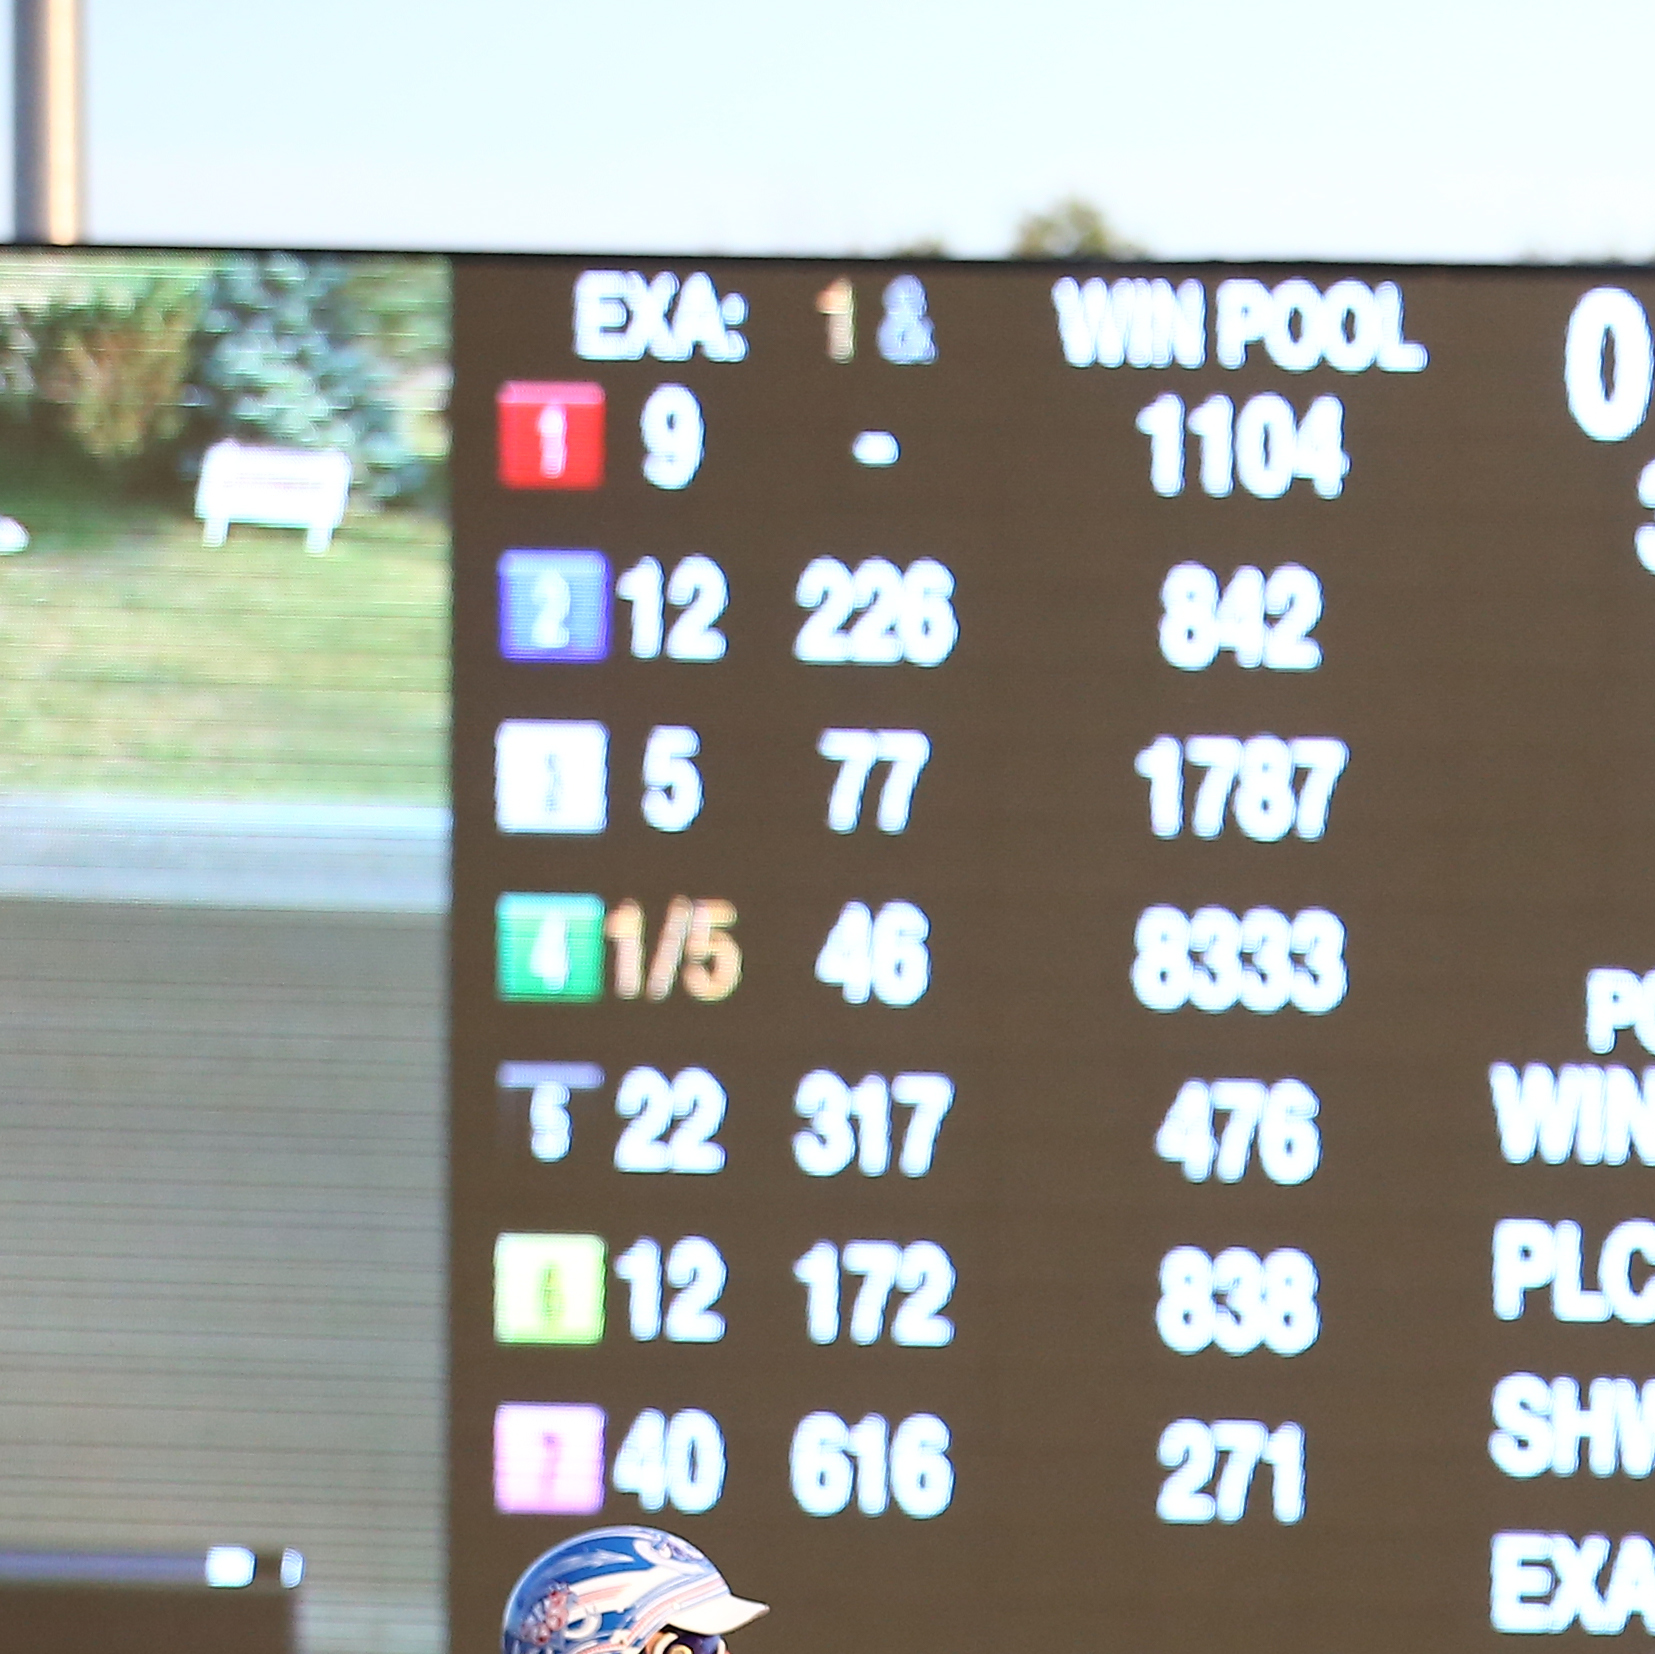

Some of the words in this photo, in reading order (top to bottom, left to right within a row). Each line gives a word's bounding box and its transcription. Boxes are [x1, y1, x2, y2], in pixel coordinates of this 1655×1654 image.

[574, 271, 745, 361] EXA:
[818, 276, 857, 363] 1
[1052, 277, 1205, 368] WIN
[1215, 279, 1427, 371] POOL
[1564, 287, 1654, 440] 0
[537, 402, 567, 478] 1
[640, 384, 703, 489] 9
[1136, 392, 1349, 499] 1104
[531, 567, 571, 648] 2
[616, 556, 726, 659] 12
[793, 558, 958, 666] 226
[1158, 561, 1321, 670] 842
[641, 726, 701, 831] 5
[818, 729, 929, 831] 77
[1134, 736, 1346, 841] 1787
[529, 910, 568, 991] 4
[605, 897, 743, 1001] 1/5
[815, 902, 928, 1004] 46
[1130, 906, 1347, 1012] 8333
[614, 1066, 726, 1173] 22
[792, 1070, 952, 1177] 317
[1156, 1079, 1319, 1184] 476
[614, 1236, 726, 1341] 12
[793, 1240, 955, 1346] 172
[1155, 1246, 1318, 1353] 838
[612, 1409, 725, 1513] 40
[789, 1412, 953, 1518] 616
[1157, 1419, 1305, 1522] 271
